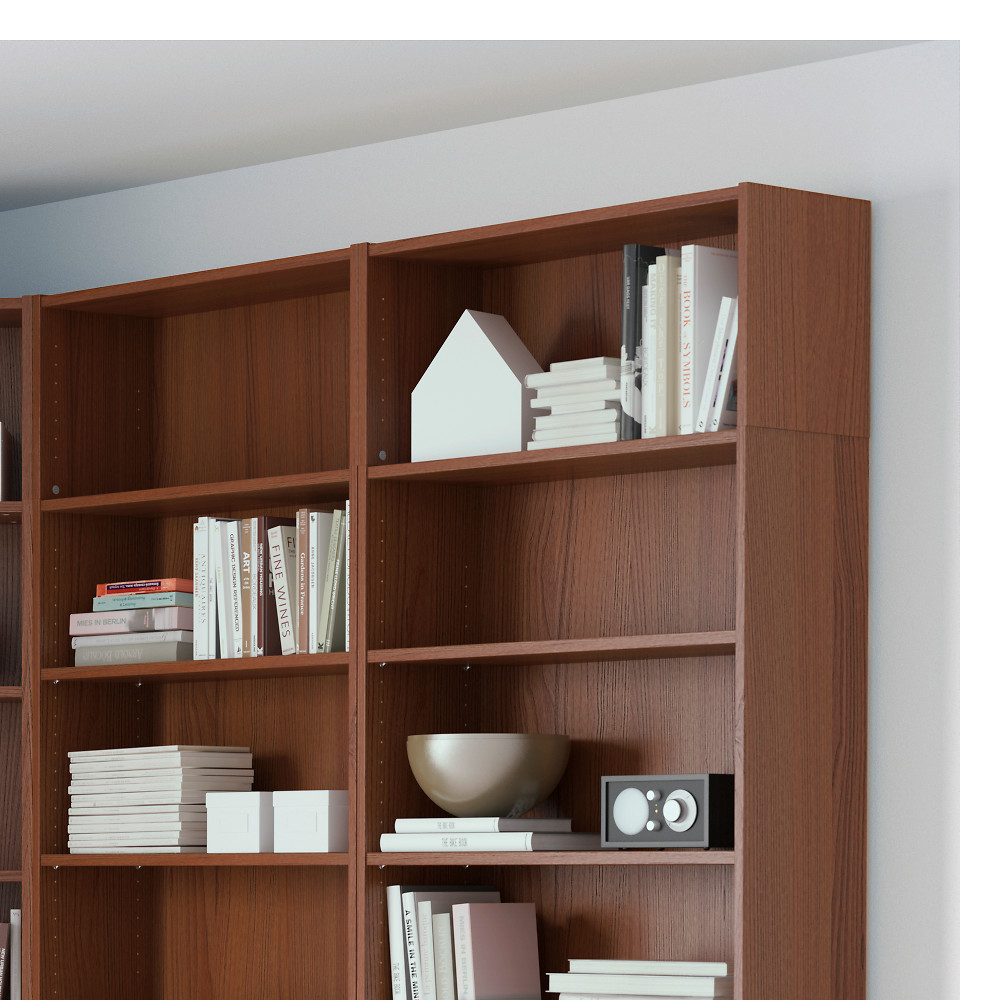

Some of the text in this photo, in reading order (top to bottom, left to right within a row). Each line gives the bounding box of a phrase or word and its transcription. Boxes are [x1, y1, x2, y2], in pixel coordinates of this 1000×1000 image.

[683, 290, 692, 409] BOOK SYMBOLS
[242, 551, 251, 574] ART
[271, 544, 291, 639] FINE WINES
[77, 619, 93, 627] MIES
[102, 618, 127, 626] BERLIN
[406, 919, 414, 947] SMILE
[409, 949, 416, 959] IN
[392, 962, 400, 971] THE
[410, 961, 418, 979] THE
[394, 983, 402, 995] BOOK
